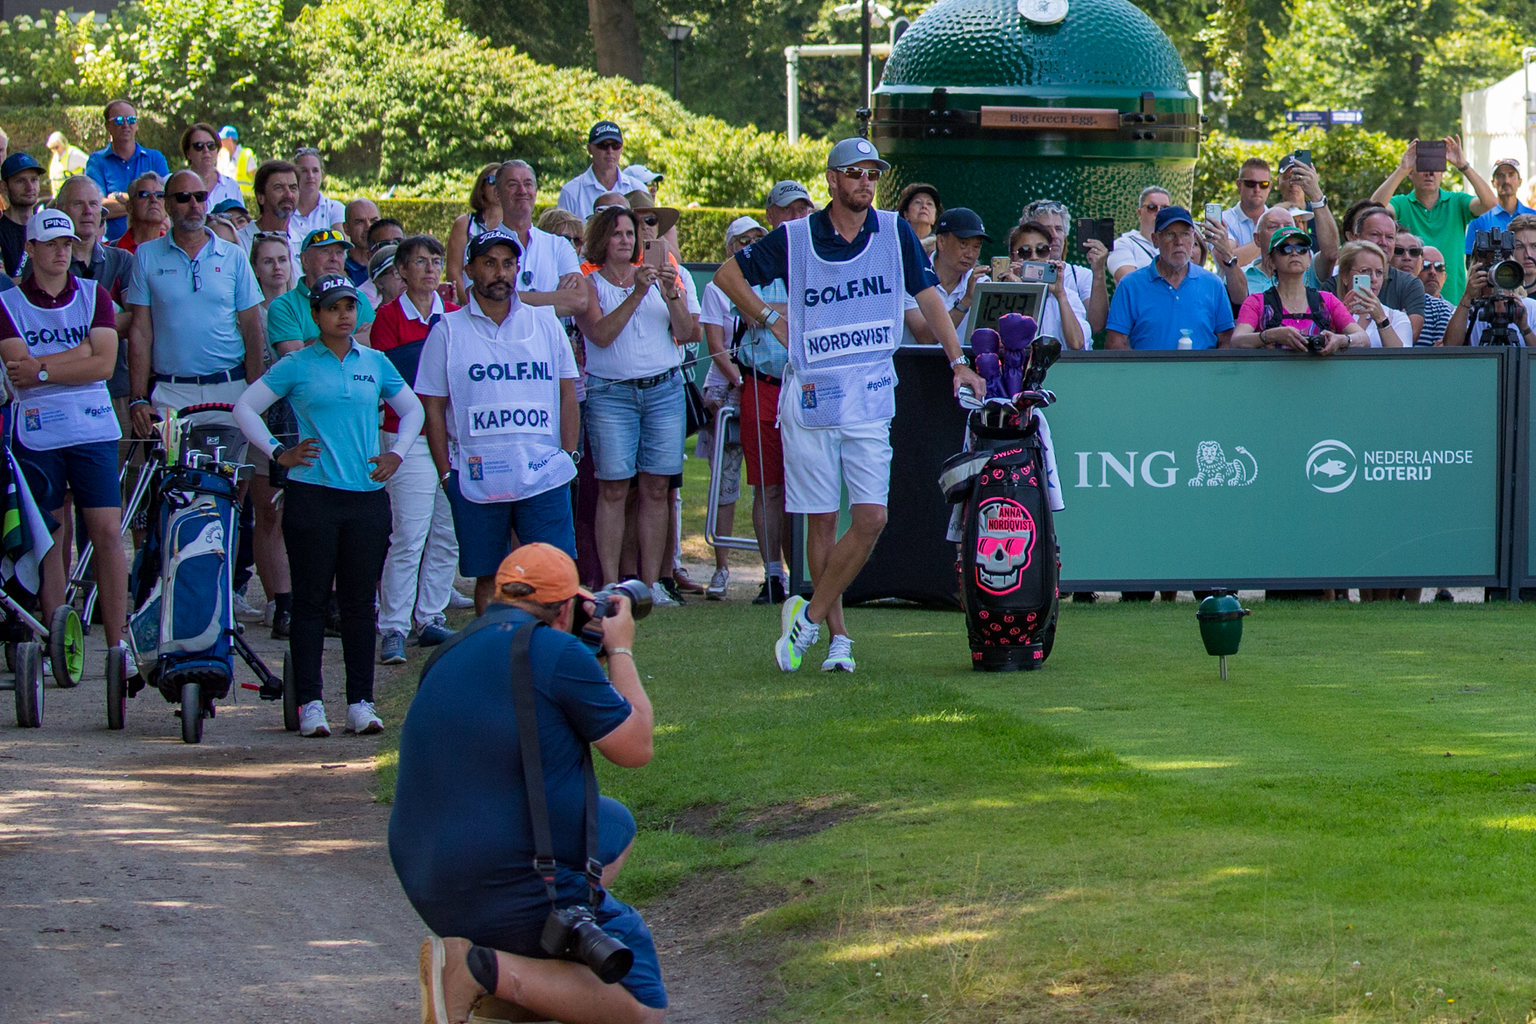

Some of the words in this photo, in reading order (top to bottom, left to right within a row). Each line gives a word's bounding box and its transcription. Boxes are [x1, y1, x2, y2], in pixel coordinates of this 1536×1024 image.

[1010, 113, 1029, 124] Big
[1032, 114, 1067, 123] Green
[45, 219, 70, 228] PING
[804, 275, 892, 308] GOLF.NL
[808, 326, 890, 356] NORDQVIST
[468, 361, 553, 382] GOLF.NL
[473, 408, 549, 430] KAPOOR
[1364, 450, 1473, 465] NEDERLANDSE
[1074, 450, 1180, 488] ING
[1364, 466, 1432, 481] LOTERIJ
[998, 507, 1022, 518] ANNA
[987, 518, 1032, 531] NORDQVIST
